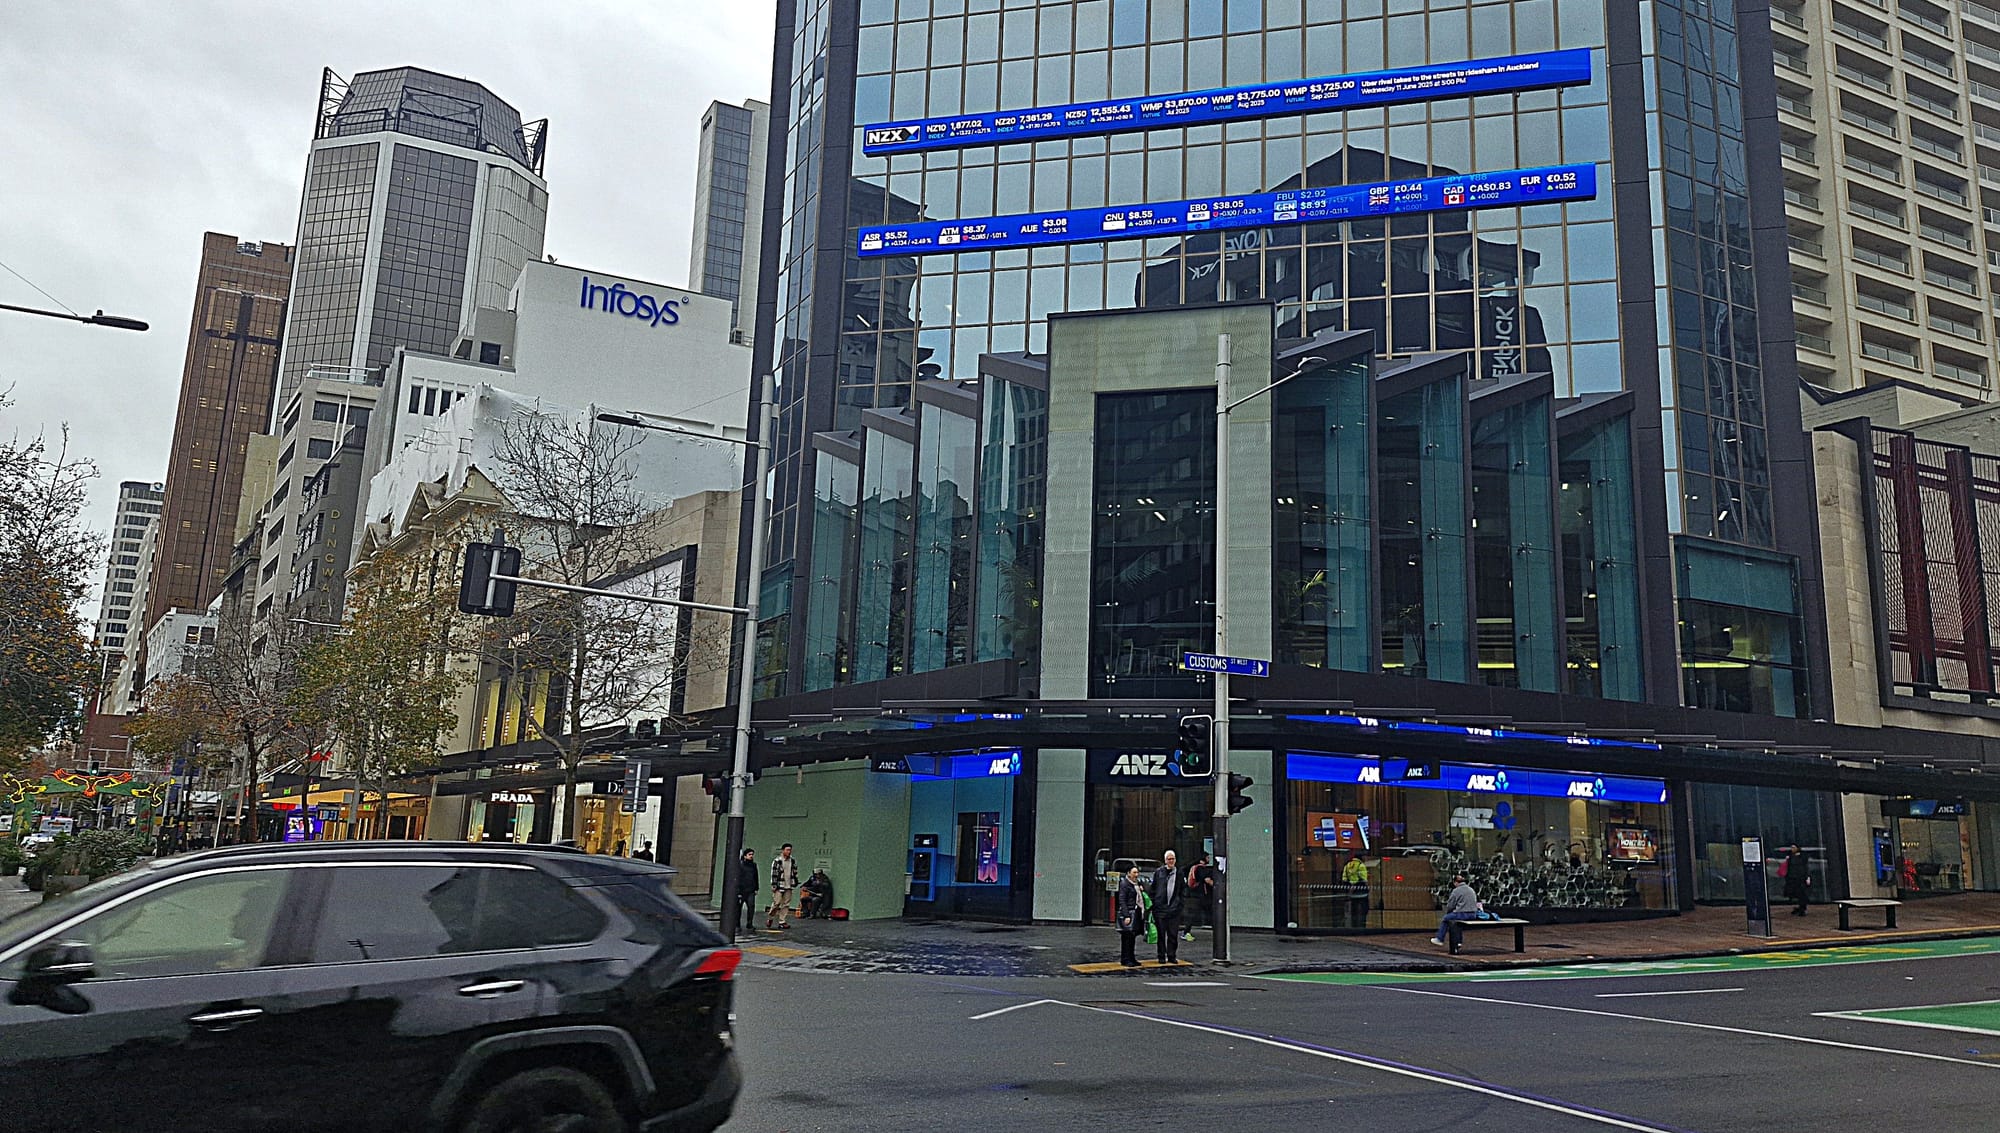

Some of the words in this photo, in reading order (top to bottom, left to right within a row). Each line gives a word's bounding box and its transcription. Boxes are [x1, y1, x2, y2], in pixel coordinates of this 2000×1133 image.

[1465, 66, 1497, 76] rideshare
[1506, 62, 1539, 72] Auckland
[1284, 87, 1307, 96] WMP
[1310, 81, 1354, 93] $3,725.00
[1361, 86, 1395, 94] Wednesday
[1212, 95, 1234, 104] WMP
[1237, 89, 1280, 101] $3,775.00
[1324, 91, 1338, 99] 2025
[1141, 102, 1162, 112] WMP
[1238, 101, 1249, 109] Aug
[1066, 110, 1086, 119] NZ50
[995, 117, 1016, 126] NZ20
[926, 124, 947, 133] NZ10
[868, 130, 902, 143] NZX
[1520, 176, 1541, 185] EUR
[1546, 173, 1576, 182] €0.52
[1370, 187, 1388, 195] GBP
[1444, 186, 1464, 194] CAD
[1190, 204, 1208, 212] EBO
[1213, 200, 1244, 210] $38.05
[1105, 213, 1124, 221] CNU
[1128, 211, 1153, 220] $8.55
[941, 227, 959, 235] ATM
[962, 225, 986, 234] $8.37
[1021, 225, 1038, 233] AUE
[1043, 219, 1067, 227] $3.08
[864, 233, 880, 241] ASR
[885, 231, 907, 240] $5.52
[580, 276, 679, 327] Infosys
[1190, 656, 1227, 670] CUSTOMS
[879, 761, 897, 770] ANZ
[989, 758, 1011, 775] ANZ
[1110, 754, 1167, 775] ANZ
[1358, 767, 1380, 782] AN
[1407, 767, 1422, 777] ANZ
[1467, 775, 1496, 790] ANZ
[1567, 782, 1594, 797] ANZ
[491, 793, 534, 803] PRADA
[1450, 807, 1494, 829] ANZ
